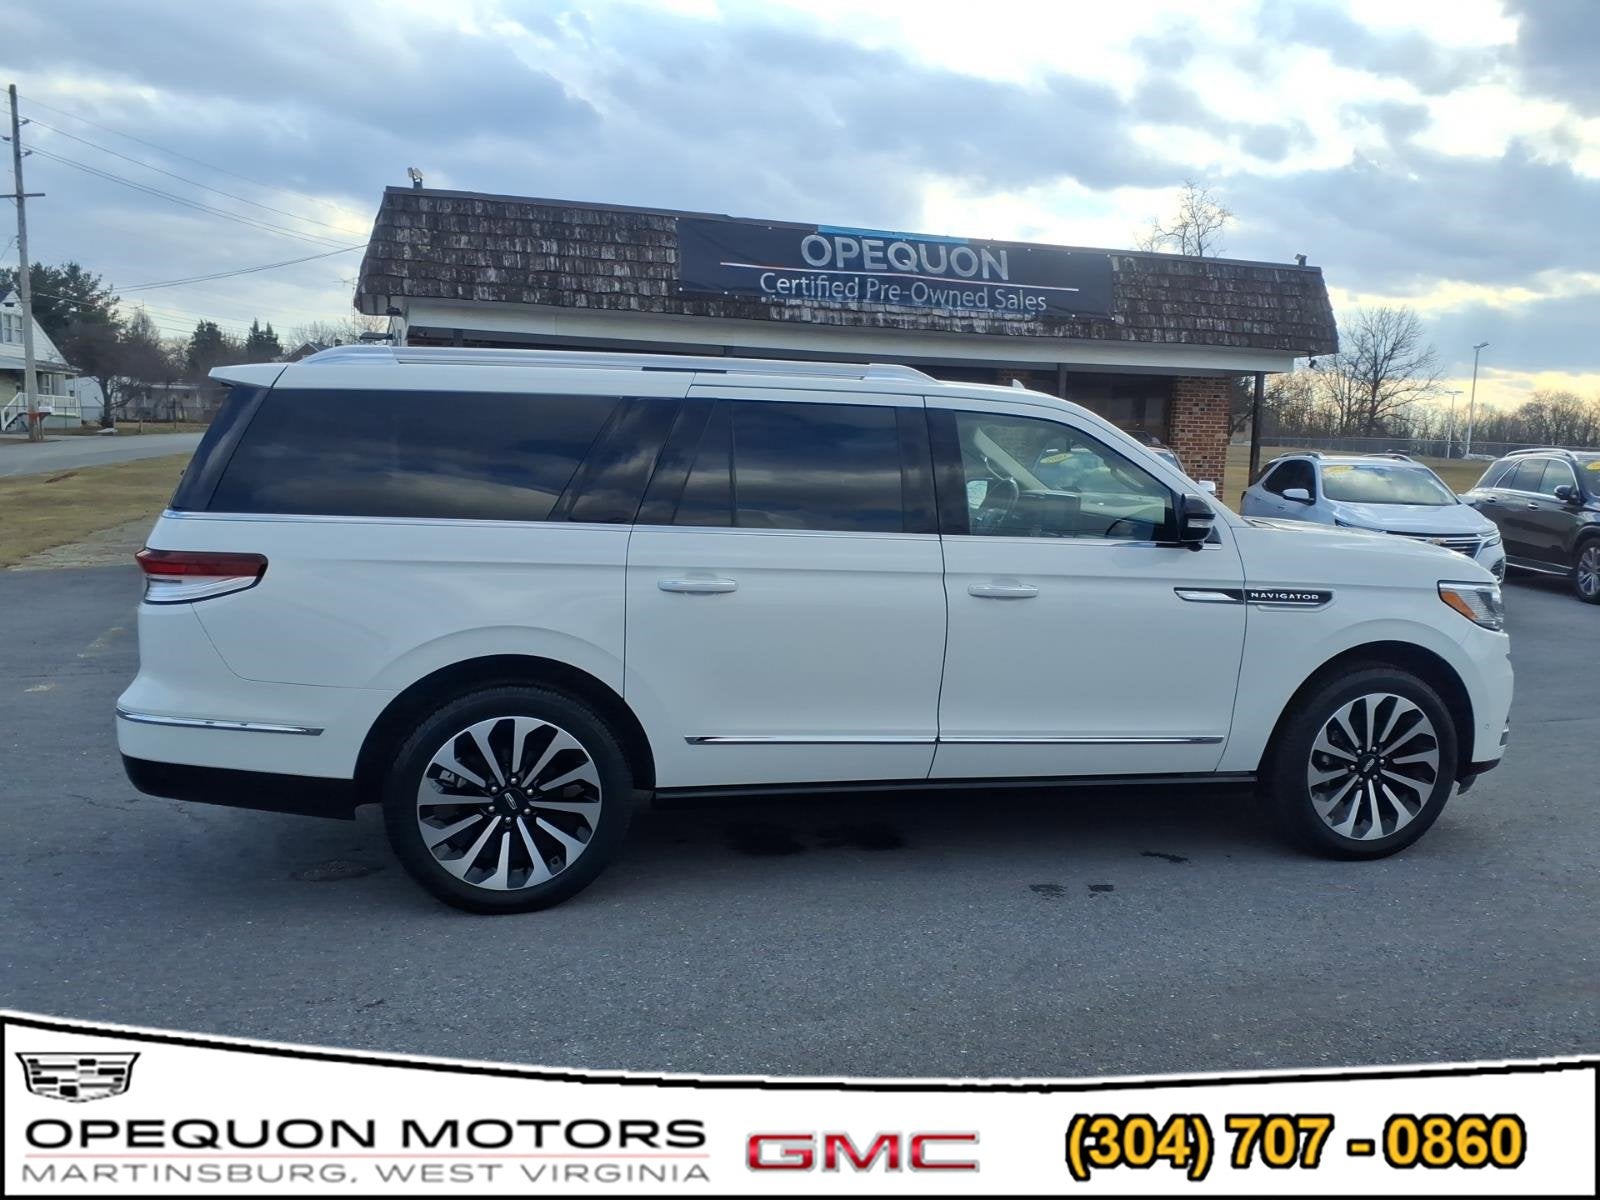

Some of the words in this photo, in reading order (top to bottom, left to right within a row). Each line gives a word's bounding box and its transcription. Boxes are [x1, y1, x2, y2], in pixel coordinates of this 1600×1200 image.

[800, 234, 1009, 280] OPEQUON
[759, 272, 859, 300] Certified
[866, 278, 989, 308] Pre-Owned
[995, 288, 1047, 311] Sales
[1250, 592, 1319, 600] NAVIGATOR
